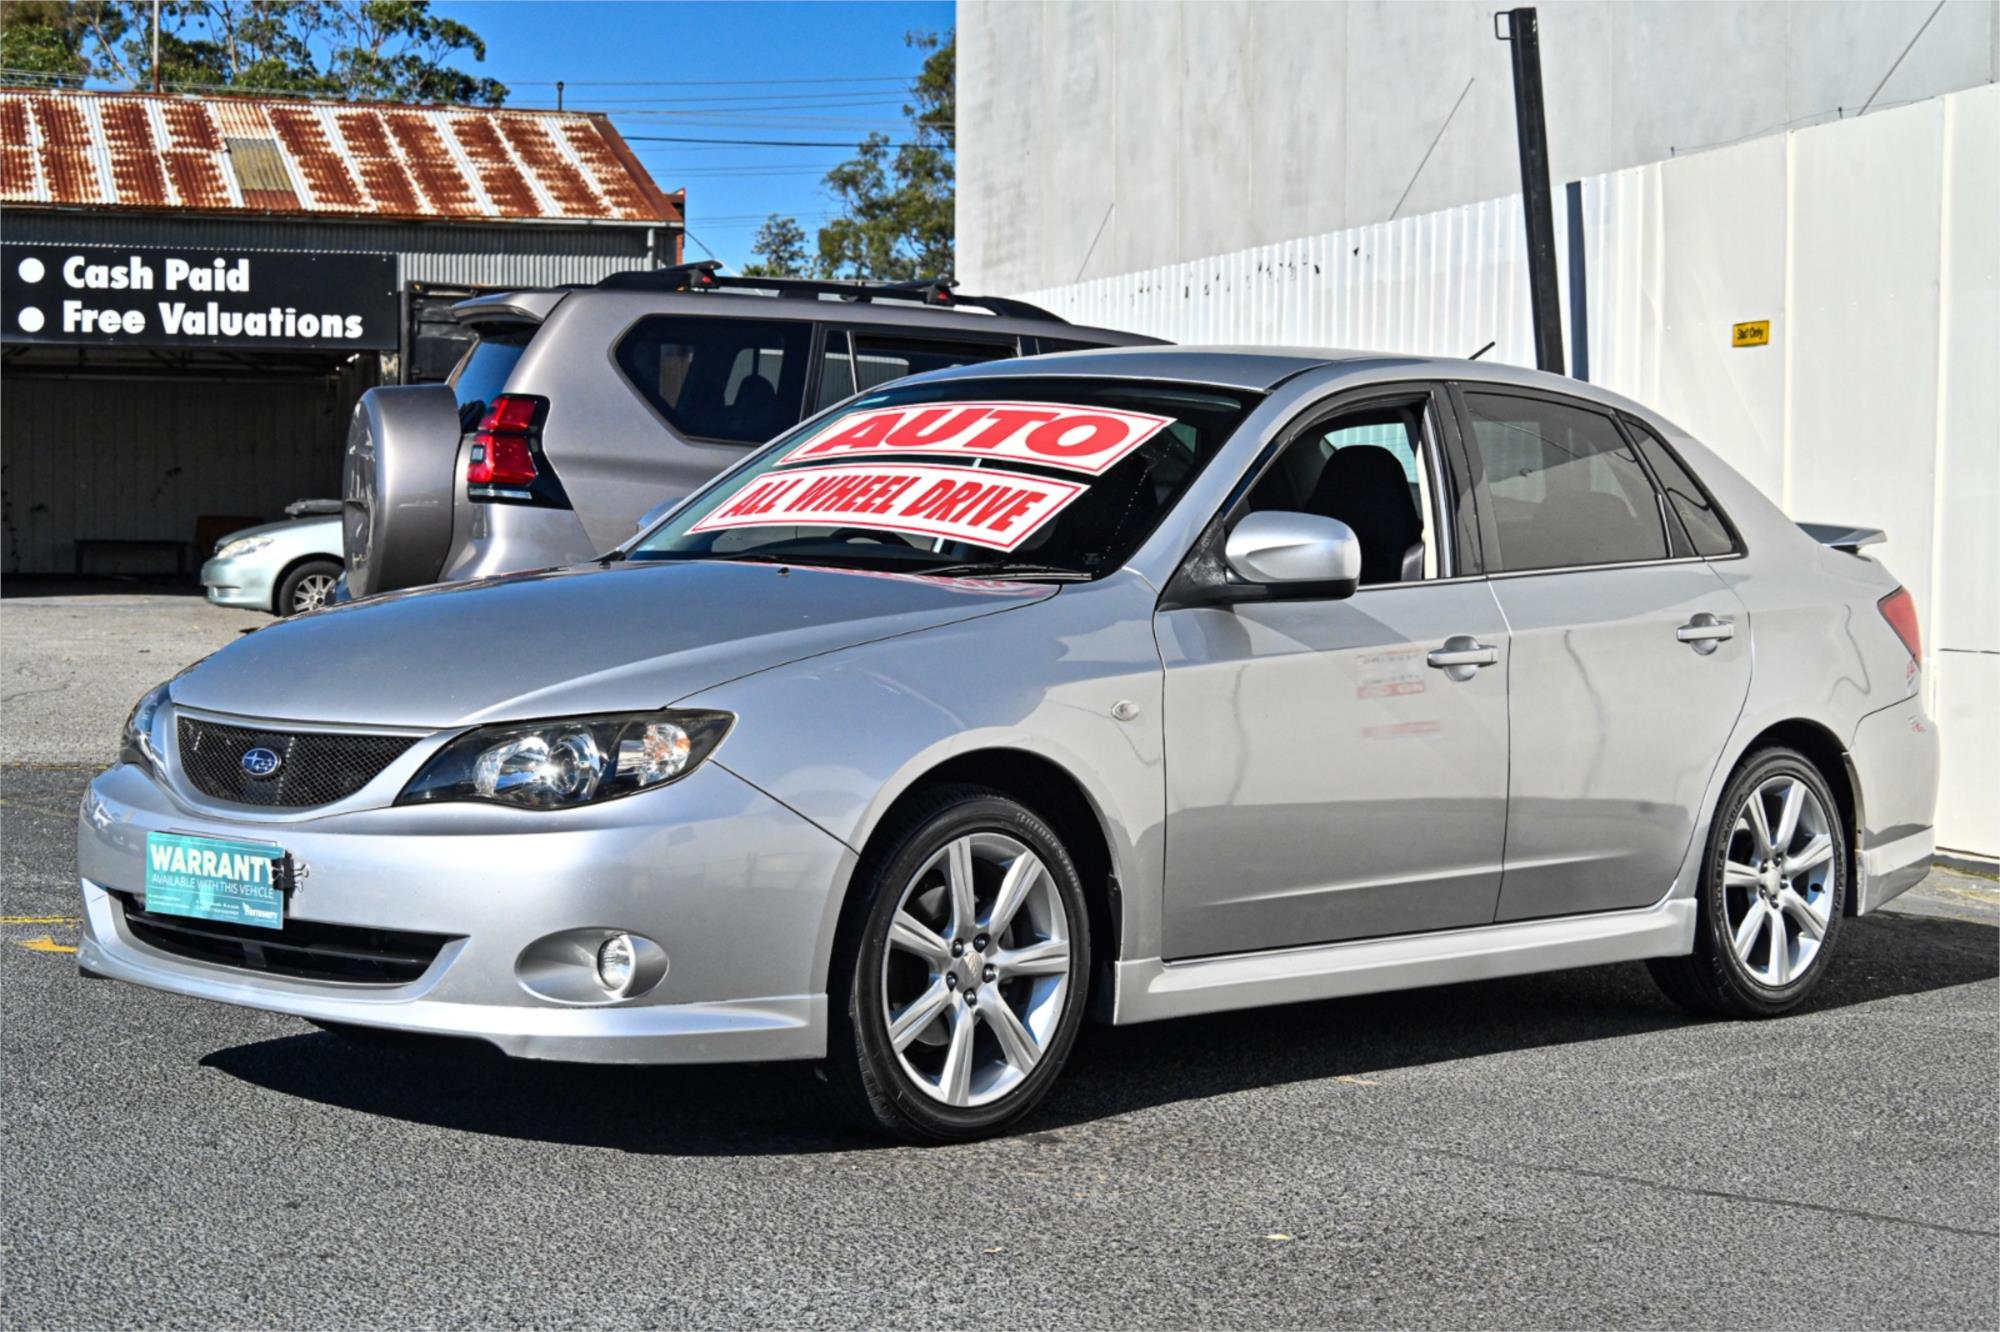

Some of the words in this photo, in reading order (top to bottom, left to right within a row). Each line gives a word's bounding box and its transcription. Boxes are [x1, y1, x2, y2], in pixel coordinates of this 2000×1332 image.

[63, 256, 154, 290] Cash
[165, 258, 250, 292] Paid
[63, 300, 146, 333] Free
[158, 302, 364, 339] Valuations
[803, 408, 1130, 457] AUTO
[720, 478, 804, 518] ALL
[783, 475, 922, 514] WHEEL
[898, 479, 1049, 532] DRIVE
[151, 874, 196, 888] AVAILABLE
[197, 879, 219, 891] WITH
[220, 882, 238, 895] THIS
[239, 884, 274, 899] VEHICLE
